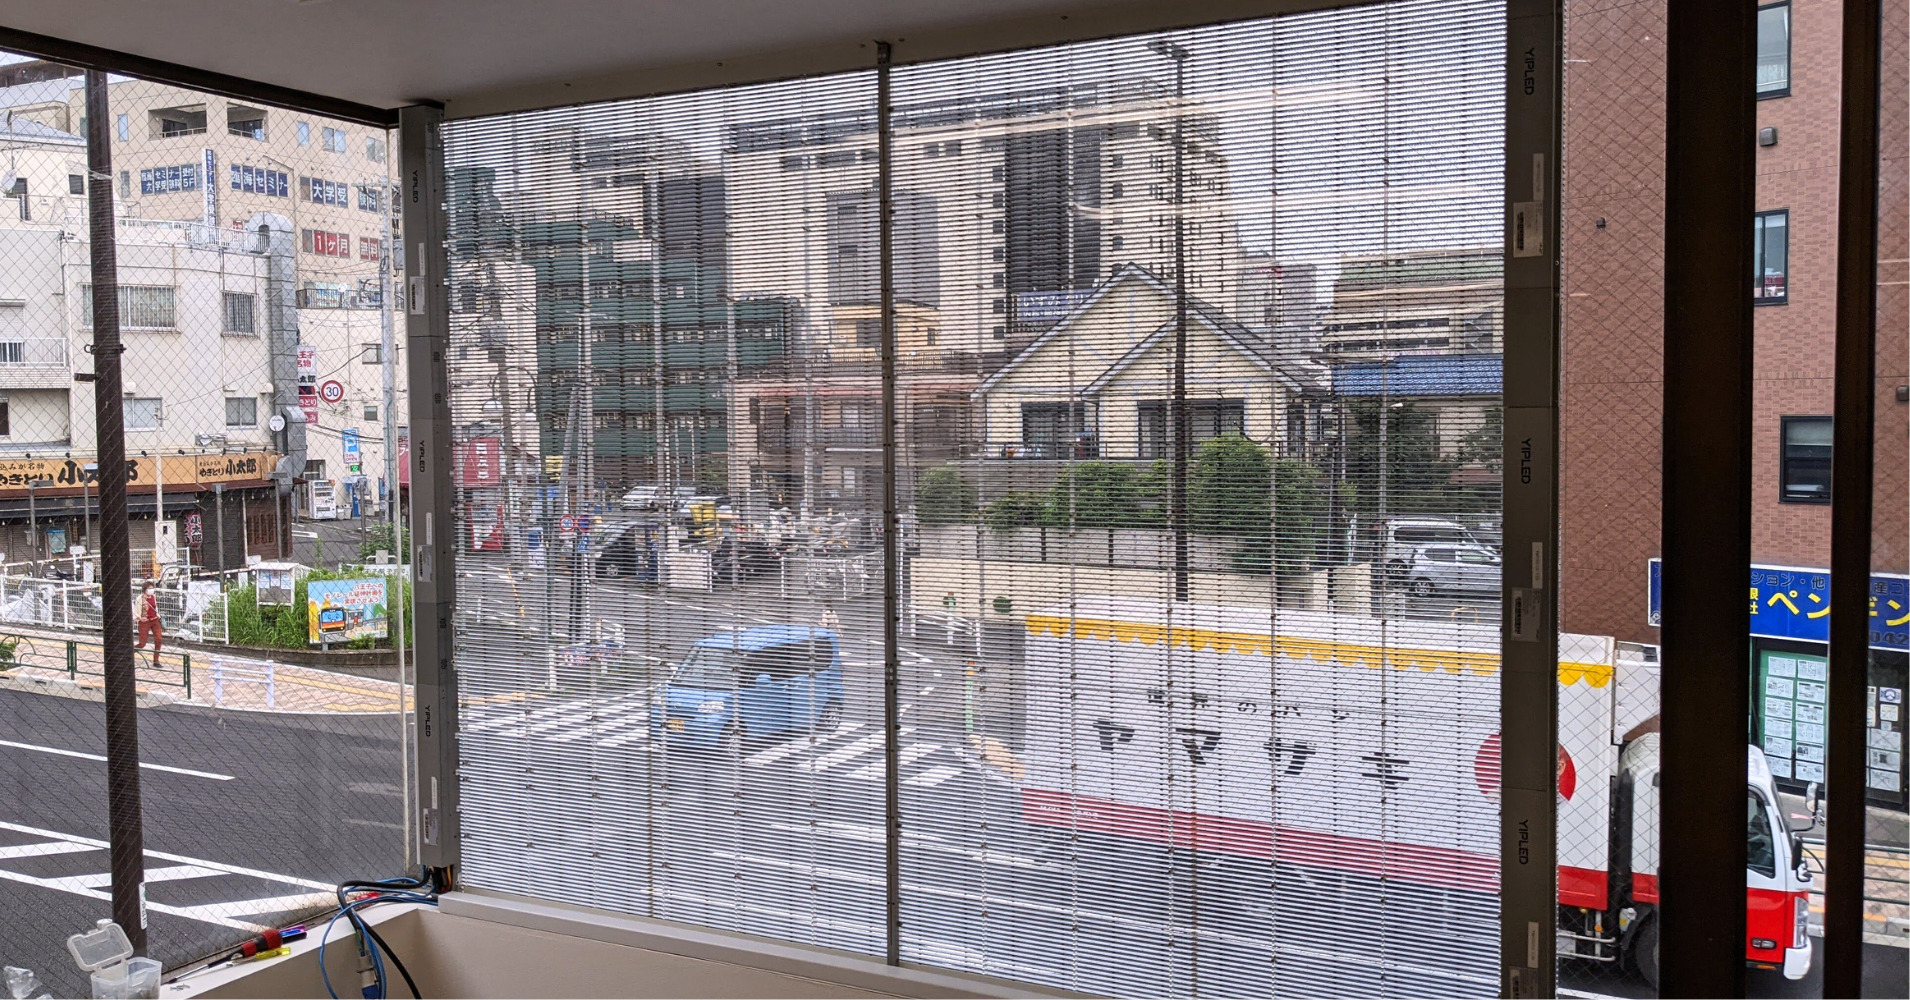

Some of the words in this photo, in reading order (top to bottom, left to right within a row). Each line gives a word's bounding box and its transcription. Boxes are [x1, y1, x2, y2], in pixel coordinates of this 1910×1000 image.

[1524, 47, 1535, 96] YIPLED
[298, 375, 316, 383] 太郎
[326, 386, 339, 397] 30
[226, 457, 257, 475] 小太郎
[1521, 437, 1531, 485] YIPLED
[1519, 819, 1529, 865] YIPLED
